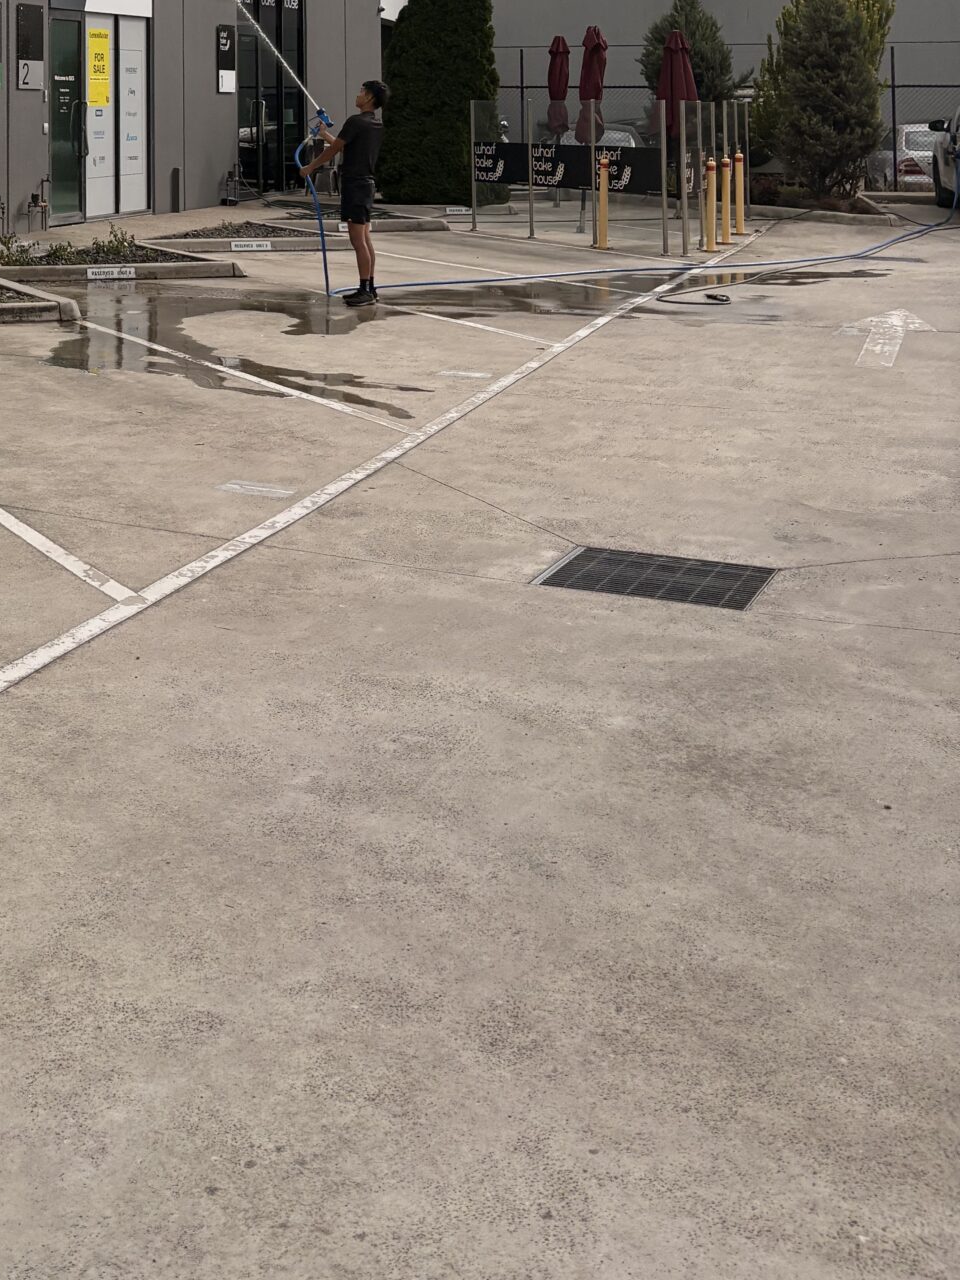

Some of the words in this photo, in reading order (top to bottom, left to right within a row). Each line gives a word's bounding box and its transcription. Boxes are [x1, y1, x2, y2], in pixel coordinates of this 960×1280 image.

[94, 53, 105, 63] FOR
[22, 62, 30, 85] 2
[93, 64, 106, 74] SALE
[475, 142, 496, 155] wharf
[533, 144, 555, 159] wharf
[475, 155, 493, 168] bake
[533, 157, 553, 172] bake
[476, 167, 500, 181] house
[533, 170, 559, 186] house
